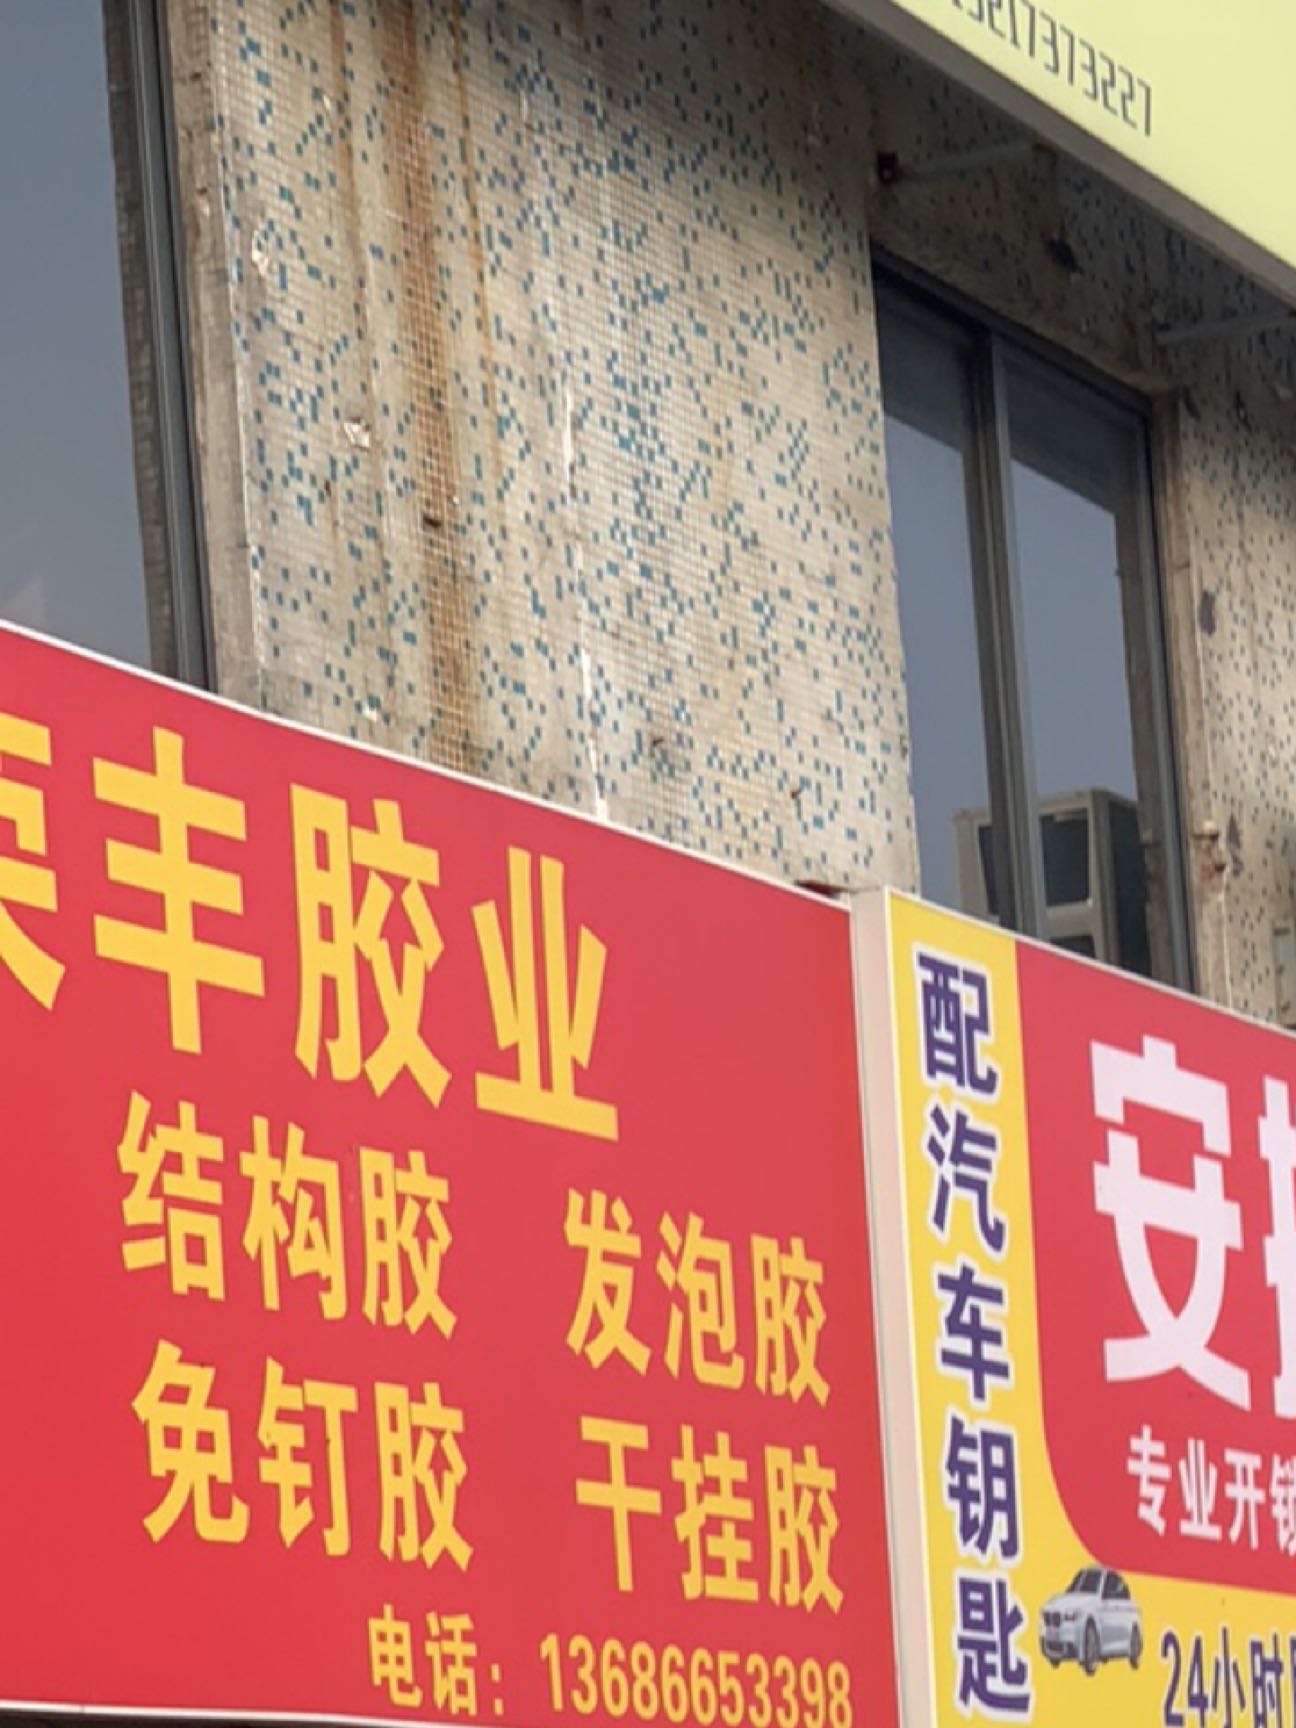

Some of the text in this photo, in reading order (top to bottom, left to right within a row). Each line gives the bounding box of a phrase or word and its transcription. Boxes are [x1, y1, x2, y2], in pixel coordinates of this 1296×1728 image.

[118, 1089, 457, 1340] 结构胶
[565, 1189, 830, 1402] 发泡胶
[914, 950, 1031, 1714] 配汽车钥匙
[134, 1338, 473, 1571] 免钉胶
[575, 1415, 844, 1614] 干挂胶
